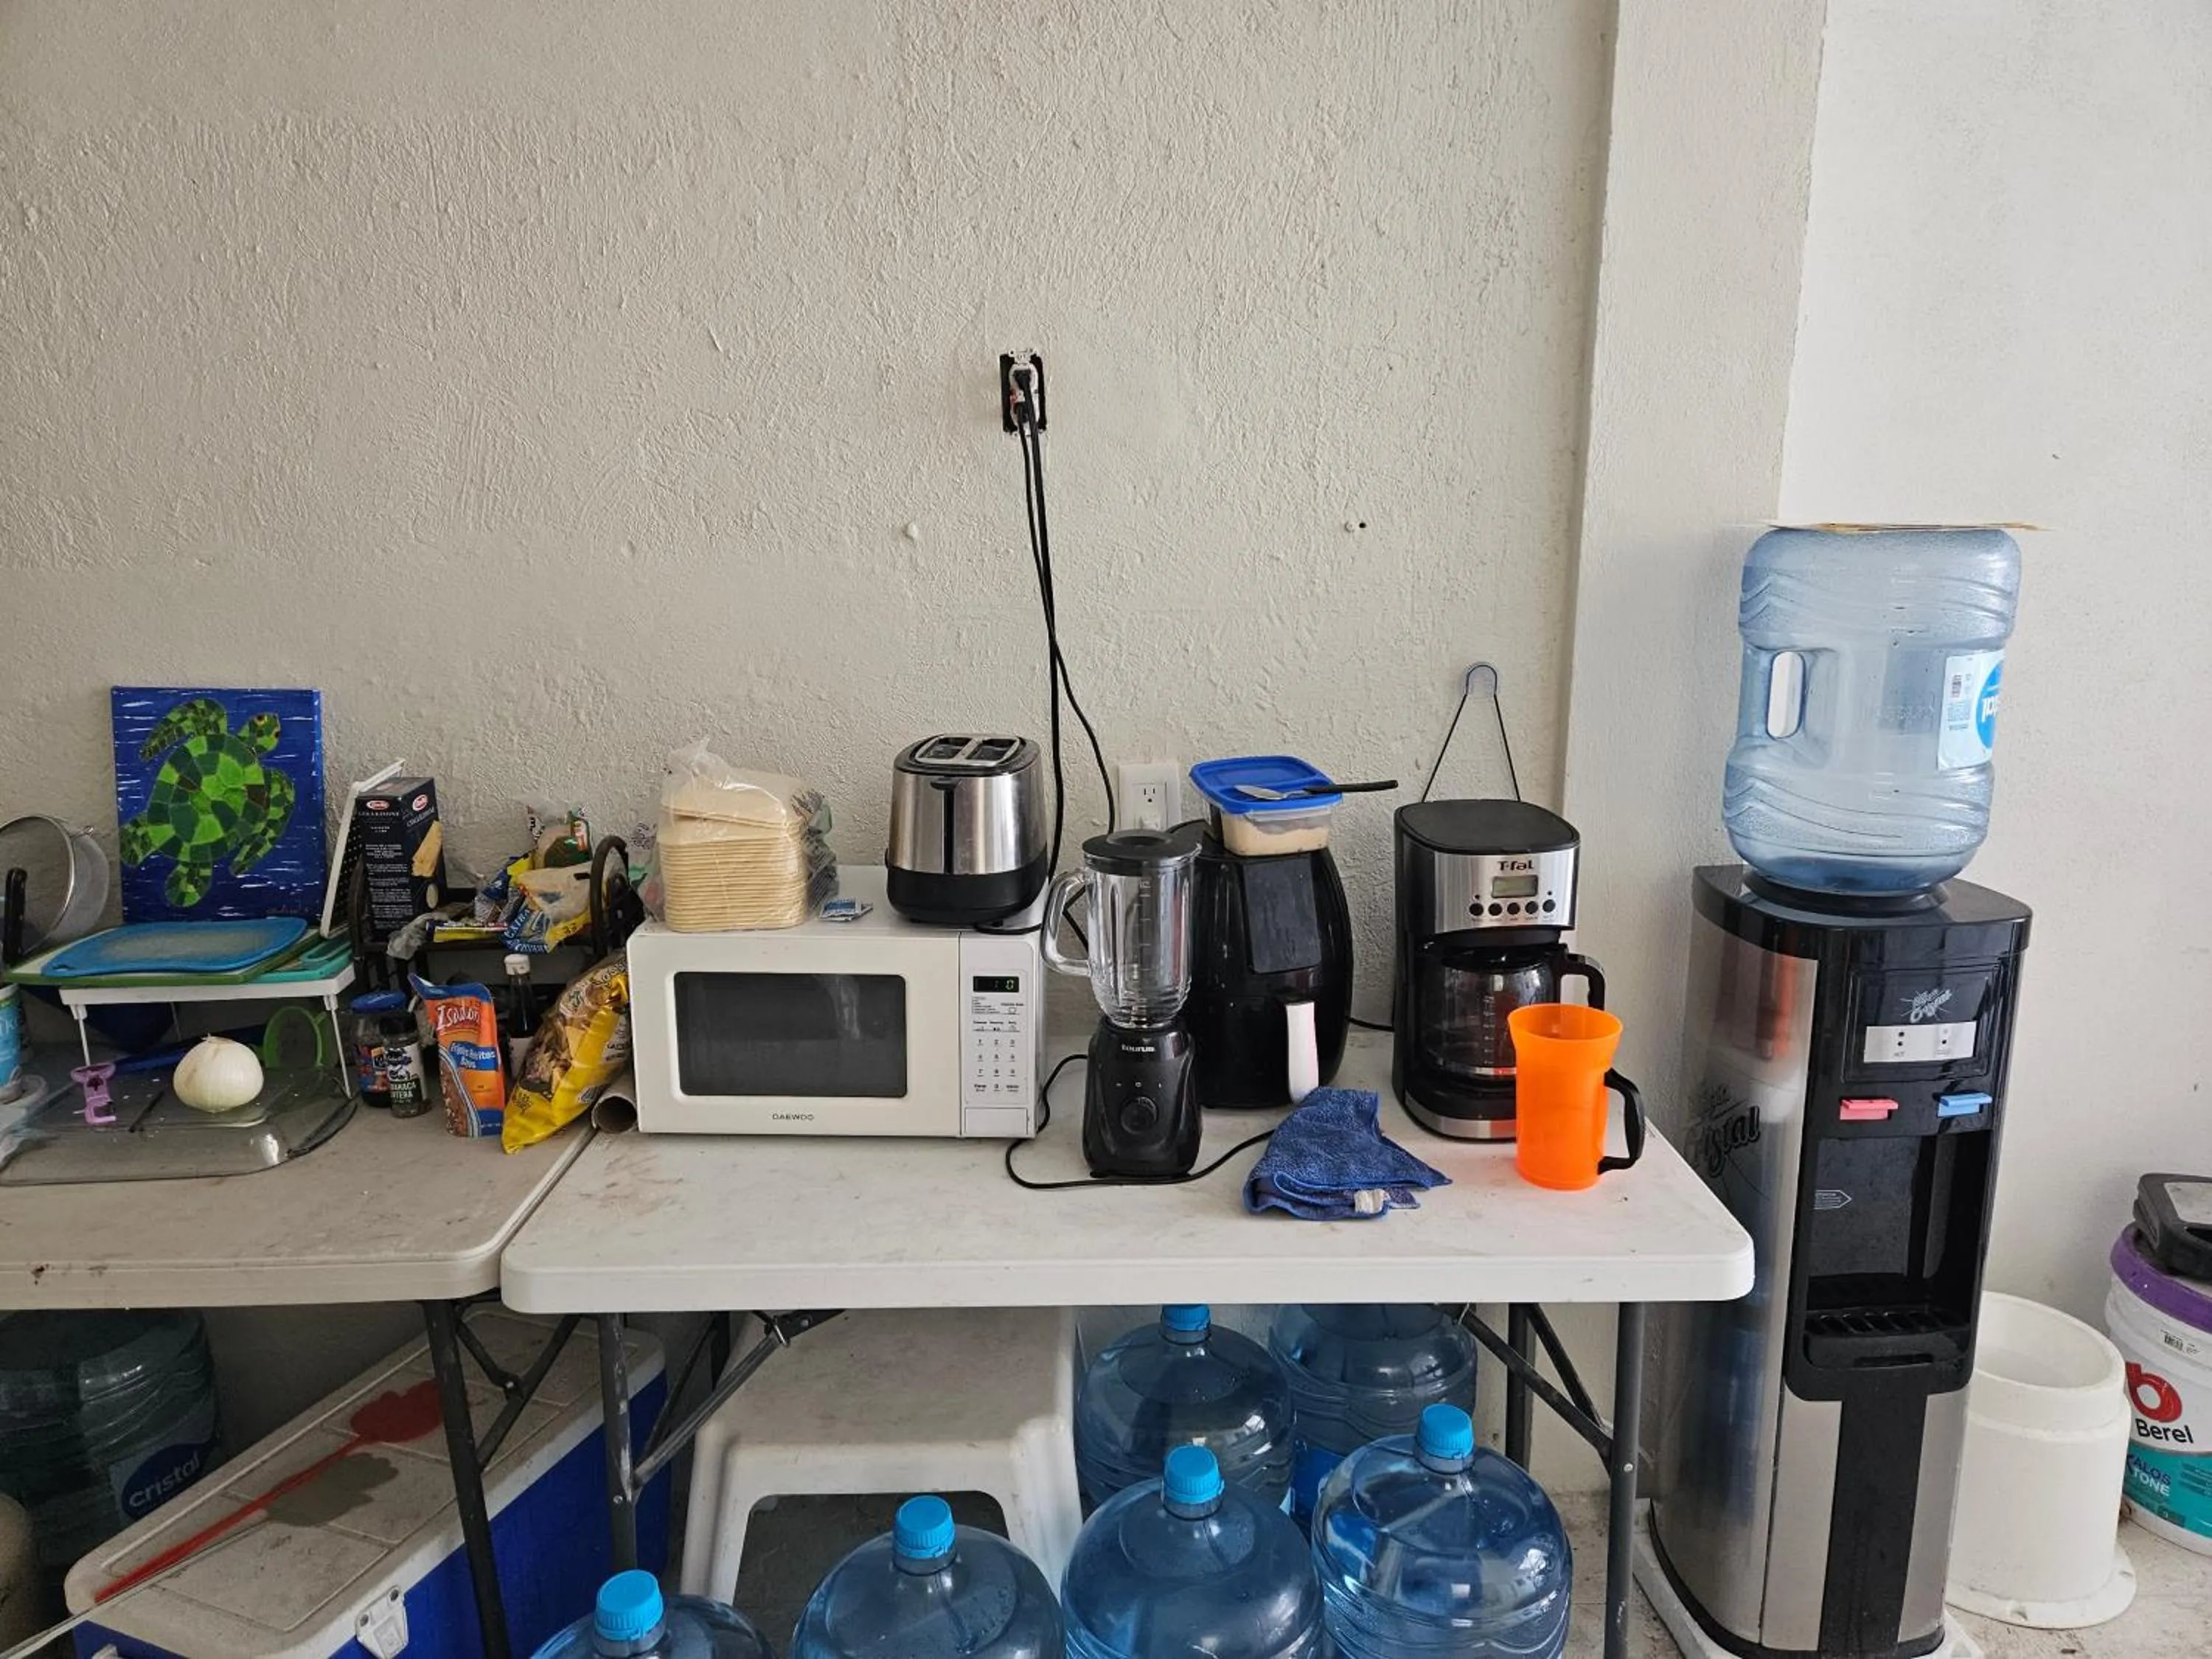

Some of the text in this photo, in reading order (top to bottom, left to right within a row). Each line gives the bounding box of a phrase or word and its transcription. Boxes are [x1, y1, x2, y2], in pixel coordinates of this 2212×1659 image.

[772, 1113, 815, 1121] DAEWOO
[2135, 1418, 2194, 1444] Berel
[129, 1450, 201, 1507] cristal
[2132, 1467, 2171, 1497] TONE
